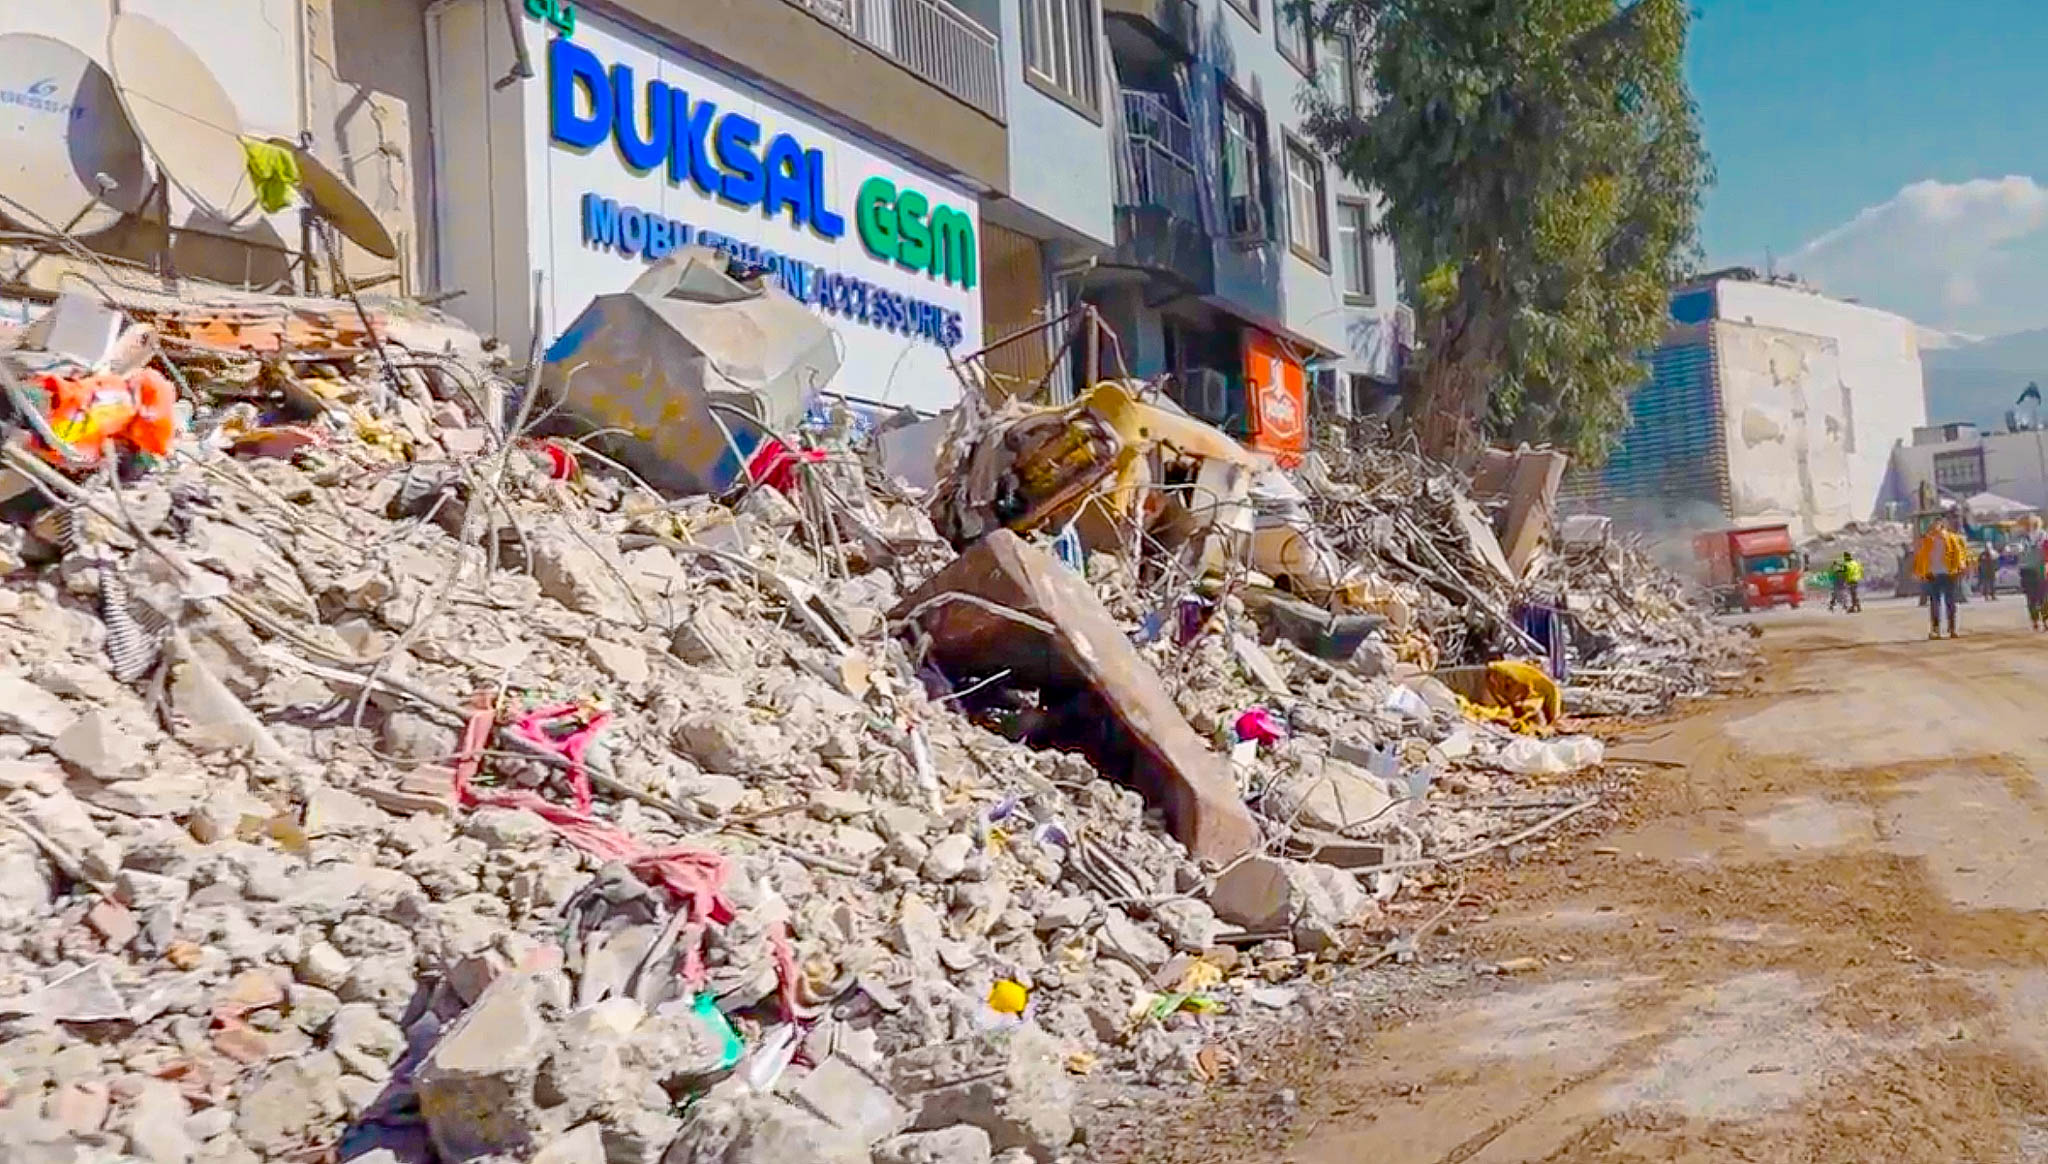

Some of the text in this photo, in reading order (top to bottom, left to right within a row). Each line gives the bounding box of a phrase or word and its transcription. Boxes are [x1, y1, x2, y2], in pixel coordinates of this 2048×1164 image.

[549, 38, 977, 290] DUKSAL GSM
[814, 267, 964, 346] ACCESSORIES
